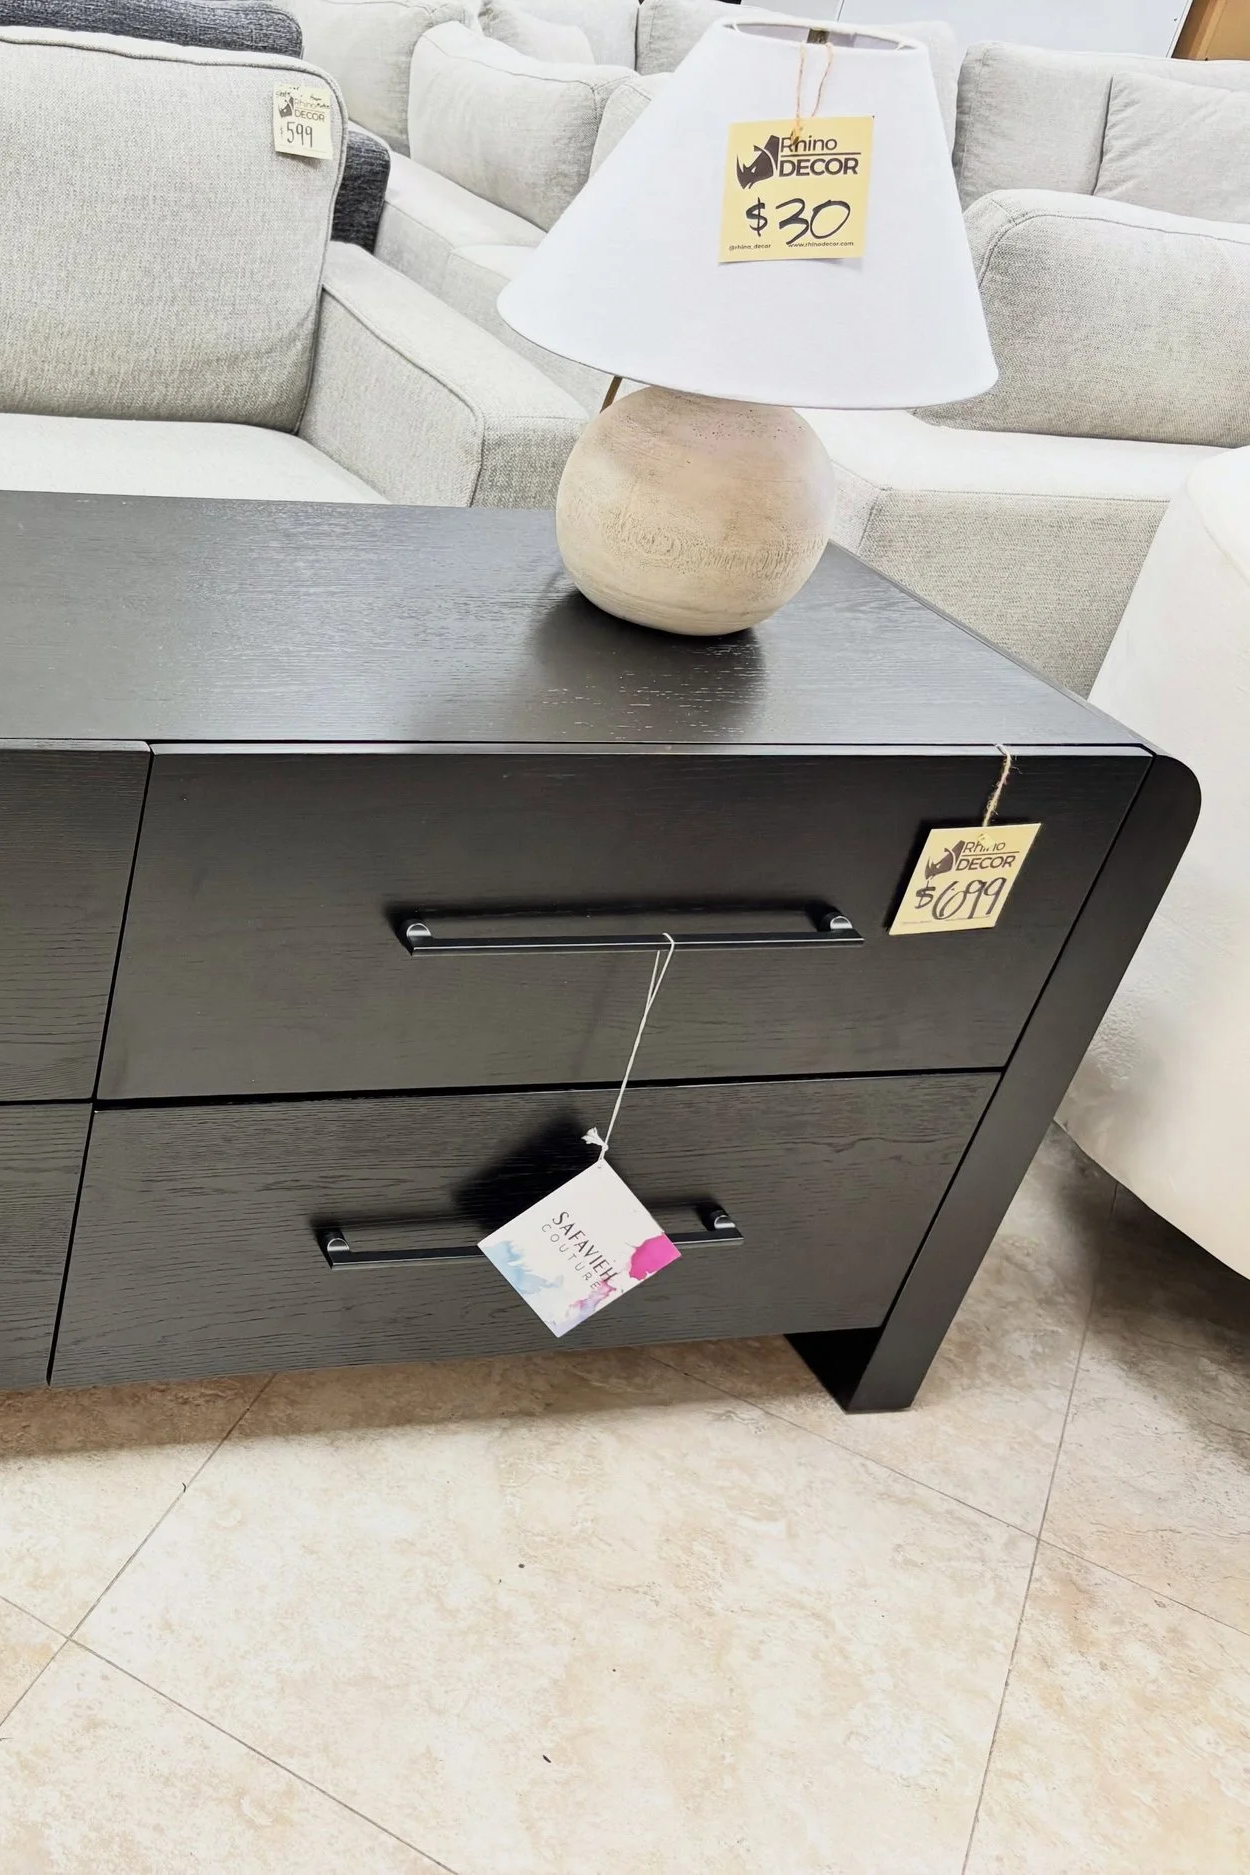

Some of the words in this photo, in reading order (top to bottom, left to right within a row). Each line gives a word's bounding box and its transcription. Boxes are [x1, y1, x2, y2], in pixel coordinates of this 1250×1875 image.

[294, 109, 325, 121] DECOR
[780, 136, 838, 153] Rhino
[778, 157, 859, 178] DECOR
[963, 841, 1006, 853] Rho
[955, 855, 1016, 871] DECOR
[915, 877, 1007, 920] $699
[541, 1223, 601, 1290] COUTURE
[552, 1211, 619, 1283] SAFAVIEH
